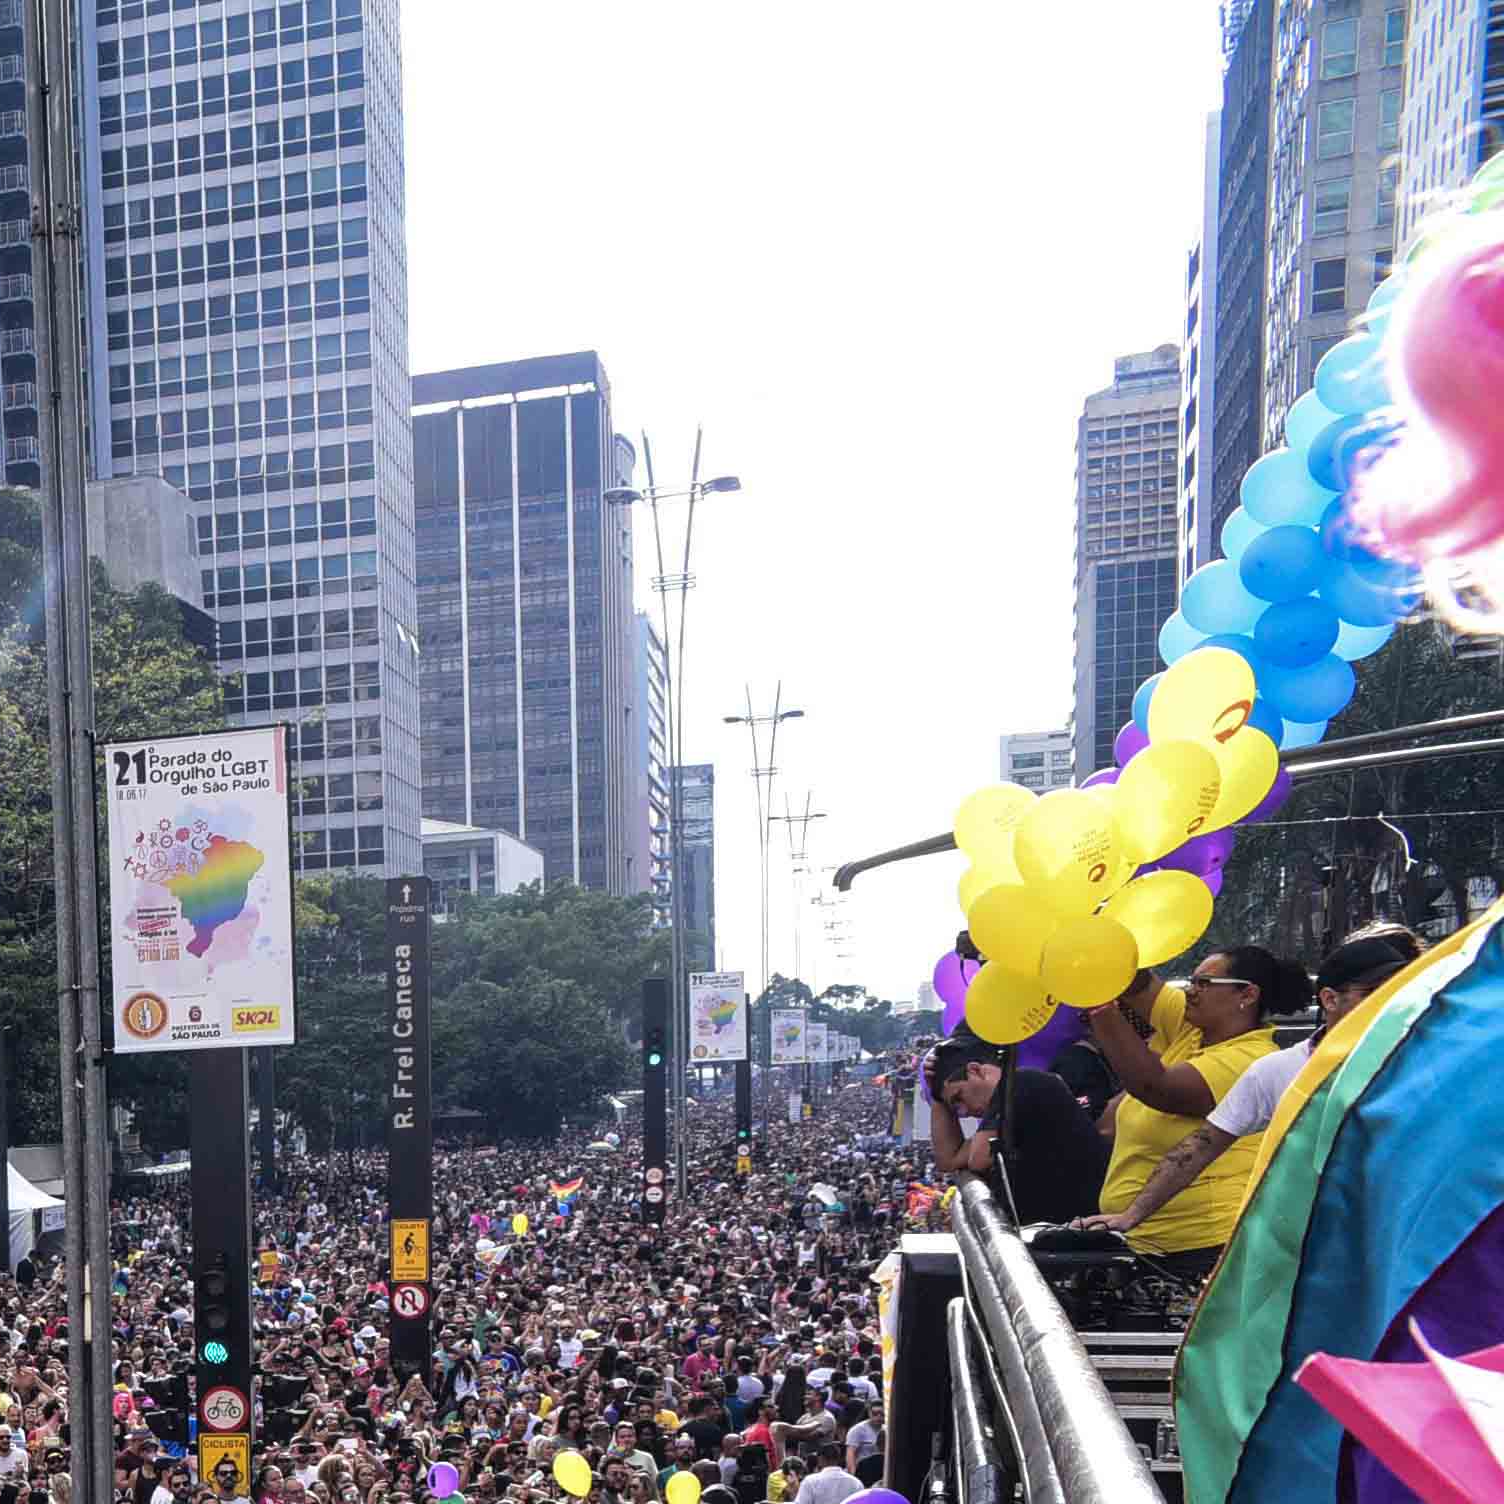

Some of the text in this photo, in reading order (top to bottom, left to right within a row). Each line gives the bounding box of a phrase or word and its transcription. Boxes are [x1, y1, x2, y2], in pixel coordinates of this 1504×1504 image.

[149, 751, 207, 769] Parada
[211, 749, 233, 763] do
[149, 760, 269, 785] Orgulho LGBT
[180, 777, 270, 796] de São Paulo
[235, 1010, 276, 1026] SKOL
[171, 1030, 221, 1041] SÃO PAULO
[393, 943, 416, 1129] R. Frei Caneca
[202, 1439, 246, 1449] CICLISTA
